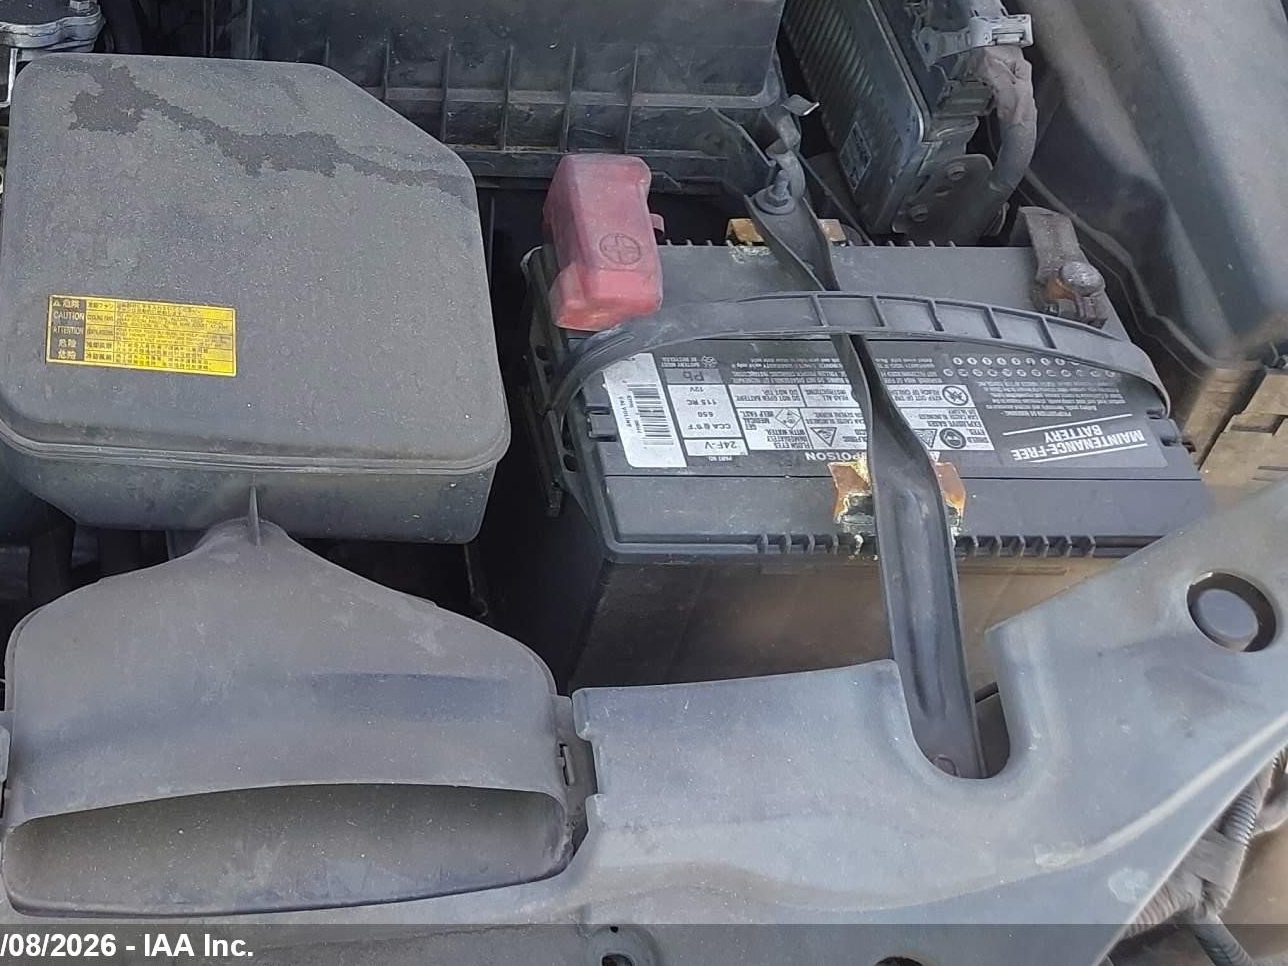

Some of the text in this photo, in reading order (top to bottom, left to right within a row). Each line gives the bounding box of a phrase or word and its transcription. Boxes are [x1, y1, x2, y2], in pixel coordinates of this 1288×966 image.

[53, 311, 85, 321] CAUTION
[682, 371, 705, 382] Pb
[1043, 424, 1103, 443] BATTERY
[704, 441, 737, 450] 24F-V
[1009, 429, 1146, 461] MAINTENANCE-FREE
